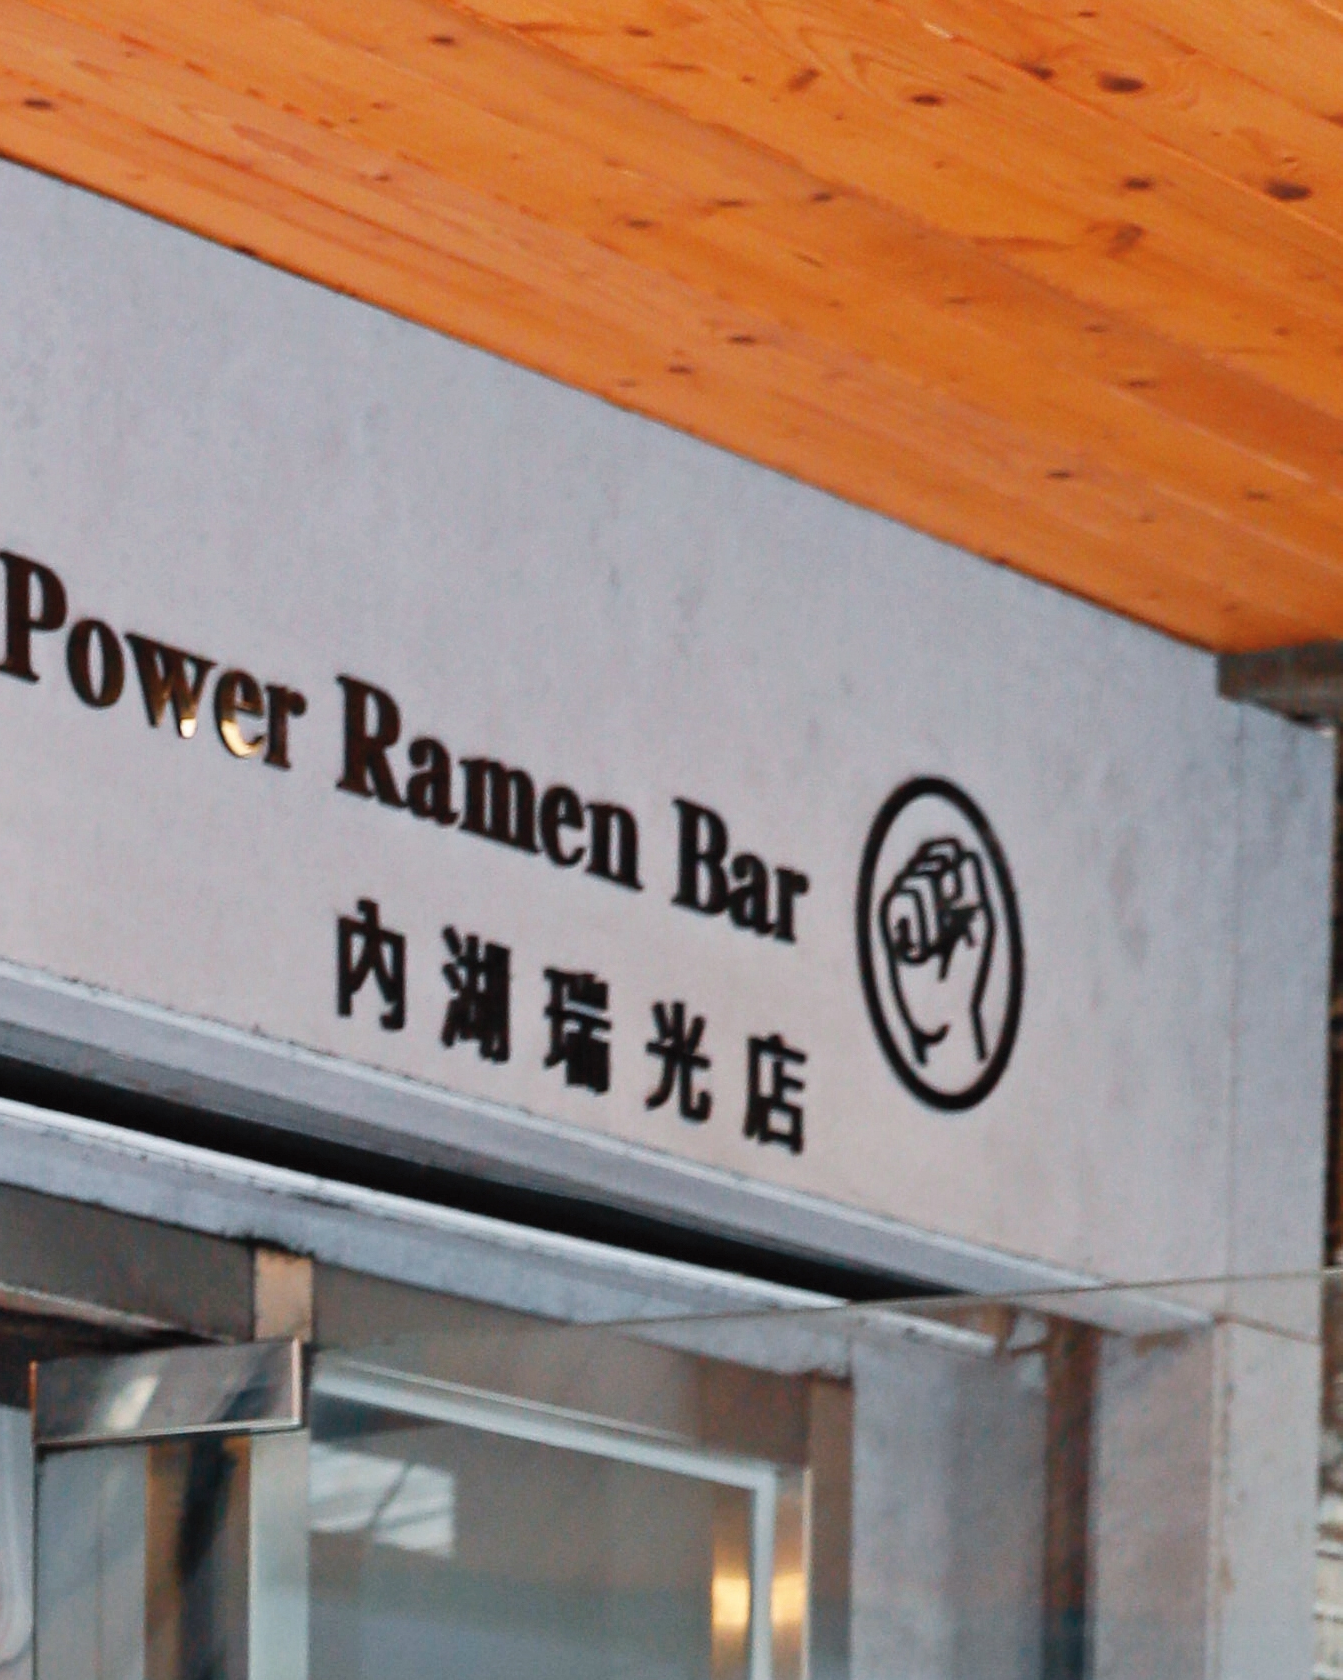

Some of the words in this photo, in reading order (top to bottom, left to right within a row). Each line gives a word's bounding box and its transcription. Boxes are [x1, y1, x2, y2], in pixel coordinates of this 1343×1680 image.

[335, 674, 643, 892] Ramen
[671, 798, 810, 943] Bar
[336, 897, 807, 1155] 內湖瑞光店
